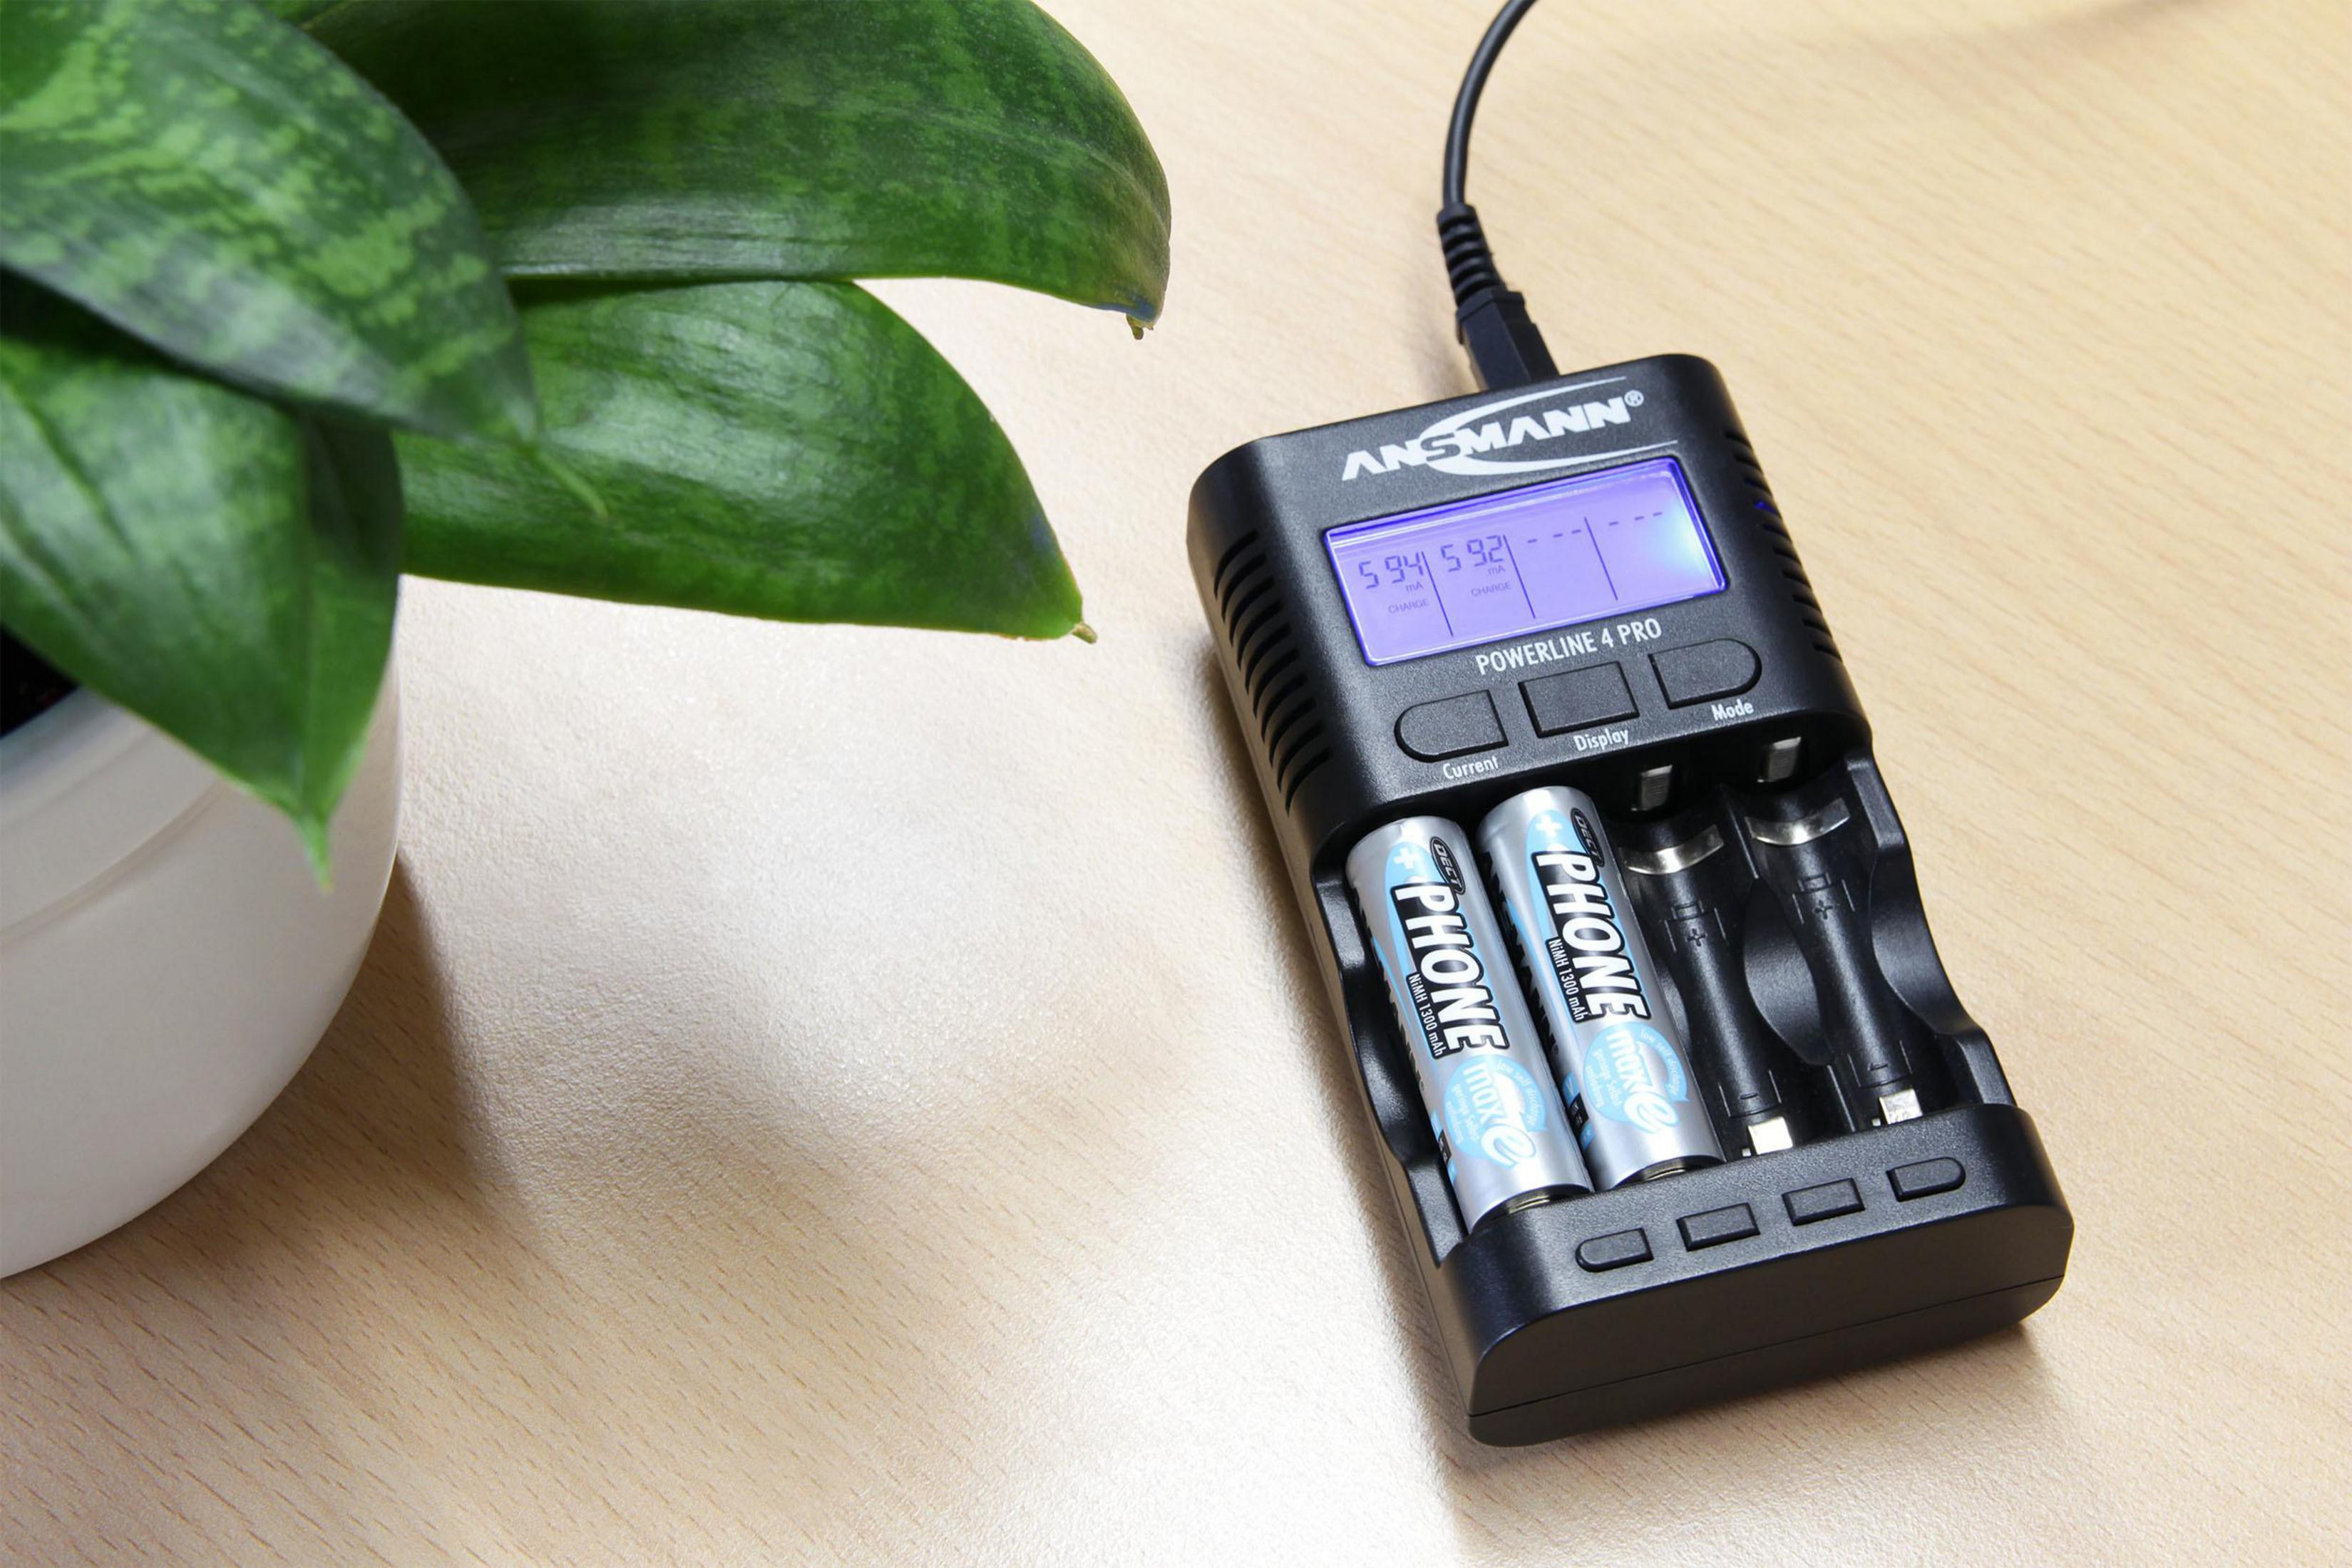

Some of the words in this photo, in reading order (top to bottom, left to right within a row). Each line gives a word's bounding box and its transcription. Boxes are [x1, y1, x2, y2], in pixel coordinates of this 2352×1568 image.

[1405, 581, 1424, 593] mA
[1487, 564, 1506, 576] mA
[1387, 598, 1429, 614] CHARGE
[1471, 581, 1511, 597] CHARGE
[1475, 630, 1597, 675] POWERLINE
[1601, 628, 1614, 649] 4
[1617, 618, 1663, 645] PRO
[1711, 698, 1754, 721] Mode
[1573, 727, 1630, 752] Display
[1442, 755, 1499, 780] Current
[1575, 815, 1602, 862] DECT
[1434, 843, 1462, 891] DECT
[1536, 854, 1648, 1016] PHONE
[1395, 886, 1506, 1050] PHONE
[1549, 939, 1569, 968] NiMH
[1559, 968, 1578, 996] 1300
[1408, 974, 1428, 1002] NiMH
[1419, 1002, 1437, 1031] 1300
[1428, 1032, 1447, 1056] mAh
[1568, 997, 1588, 1021] mAh
[1641, 1029, 1655, 1043] low
